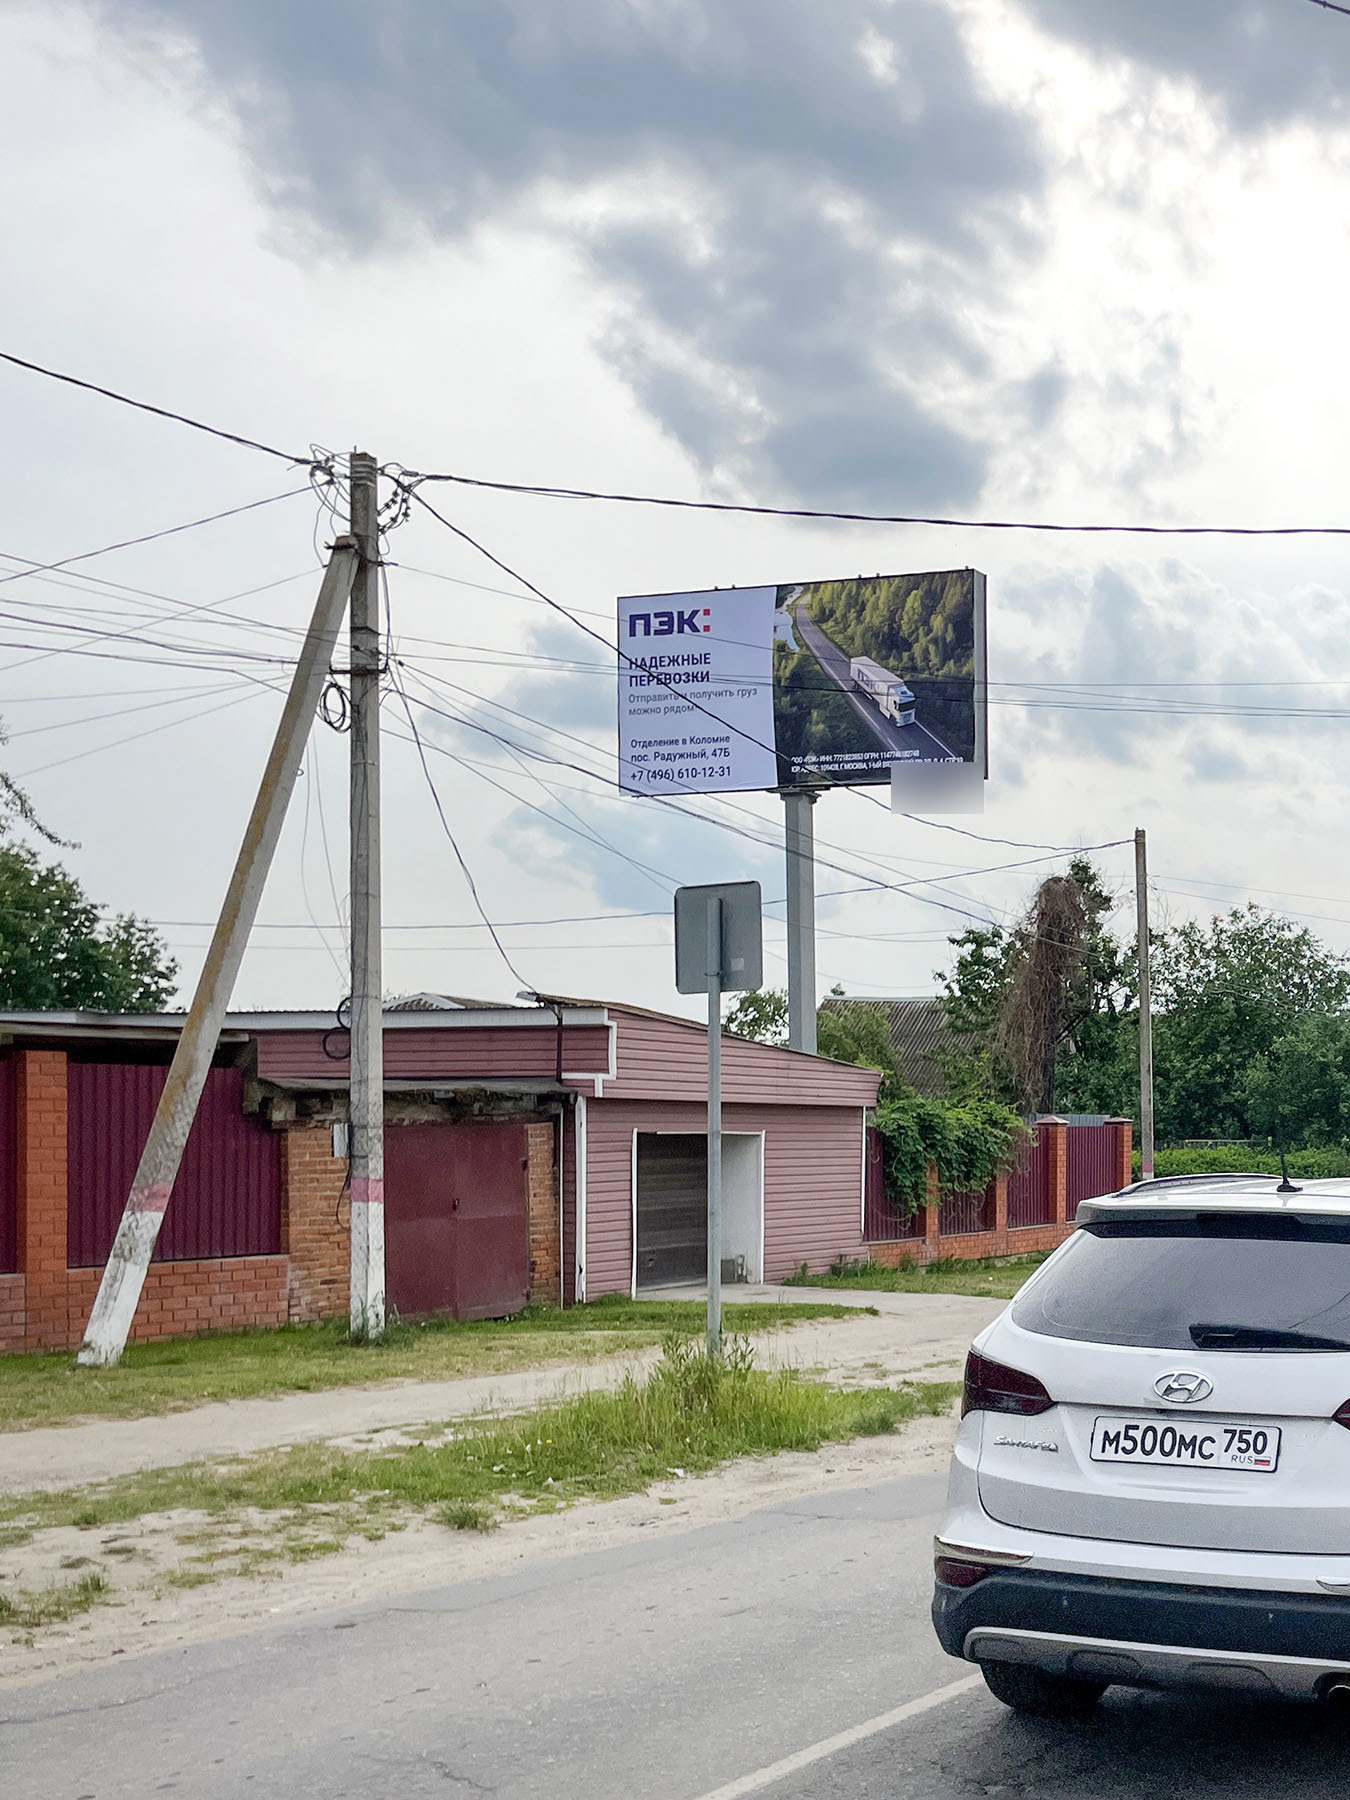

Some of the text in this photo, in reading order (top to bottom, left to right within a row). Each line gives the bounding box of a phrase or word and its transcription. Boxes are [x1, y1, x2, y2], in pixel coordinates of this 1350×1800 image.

[629, 652, 711, 670] НАДЕЖНЫЕ
[629, 671, 710, 687] ПЕРЕВОЗКИ
[628, 692, 679, 704] Отправить
[689, 690, 735, 703] получить
[737, 687, 758, 698] груз
[628, 706, 662, 716] можно
[630, 738, 680, 749] Отделение
[689, 735, 730, 745] Коломне
[630, 747, 730, 762] пос. Радужный, 47Б
[630, 766, 731, 783] +7 (496) 610-12-31
[1101, 1424, 1268, 1460] М500МС 750
[1231, 1454, 1253, 1464] RUS
